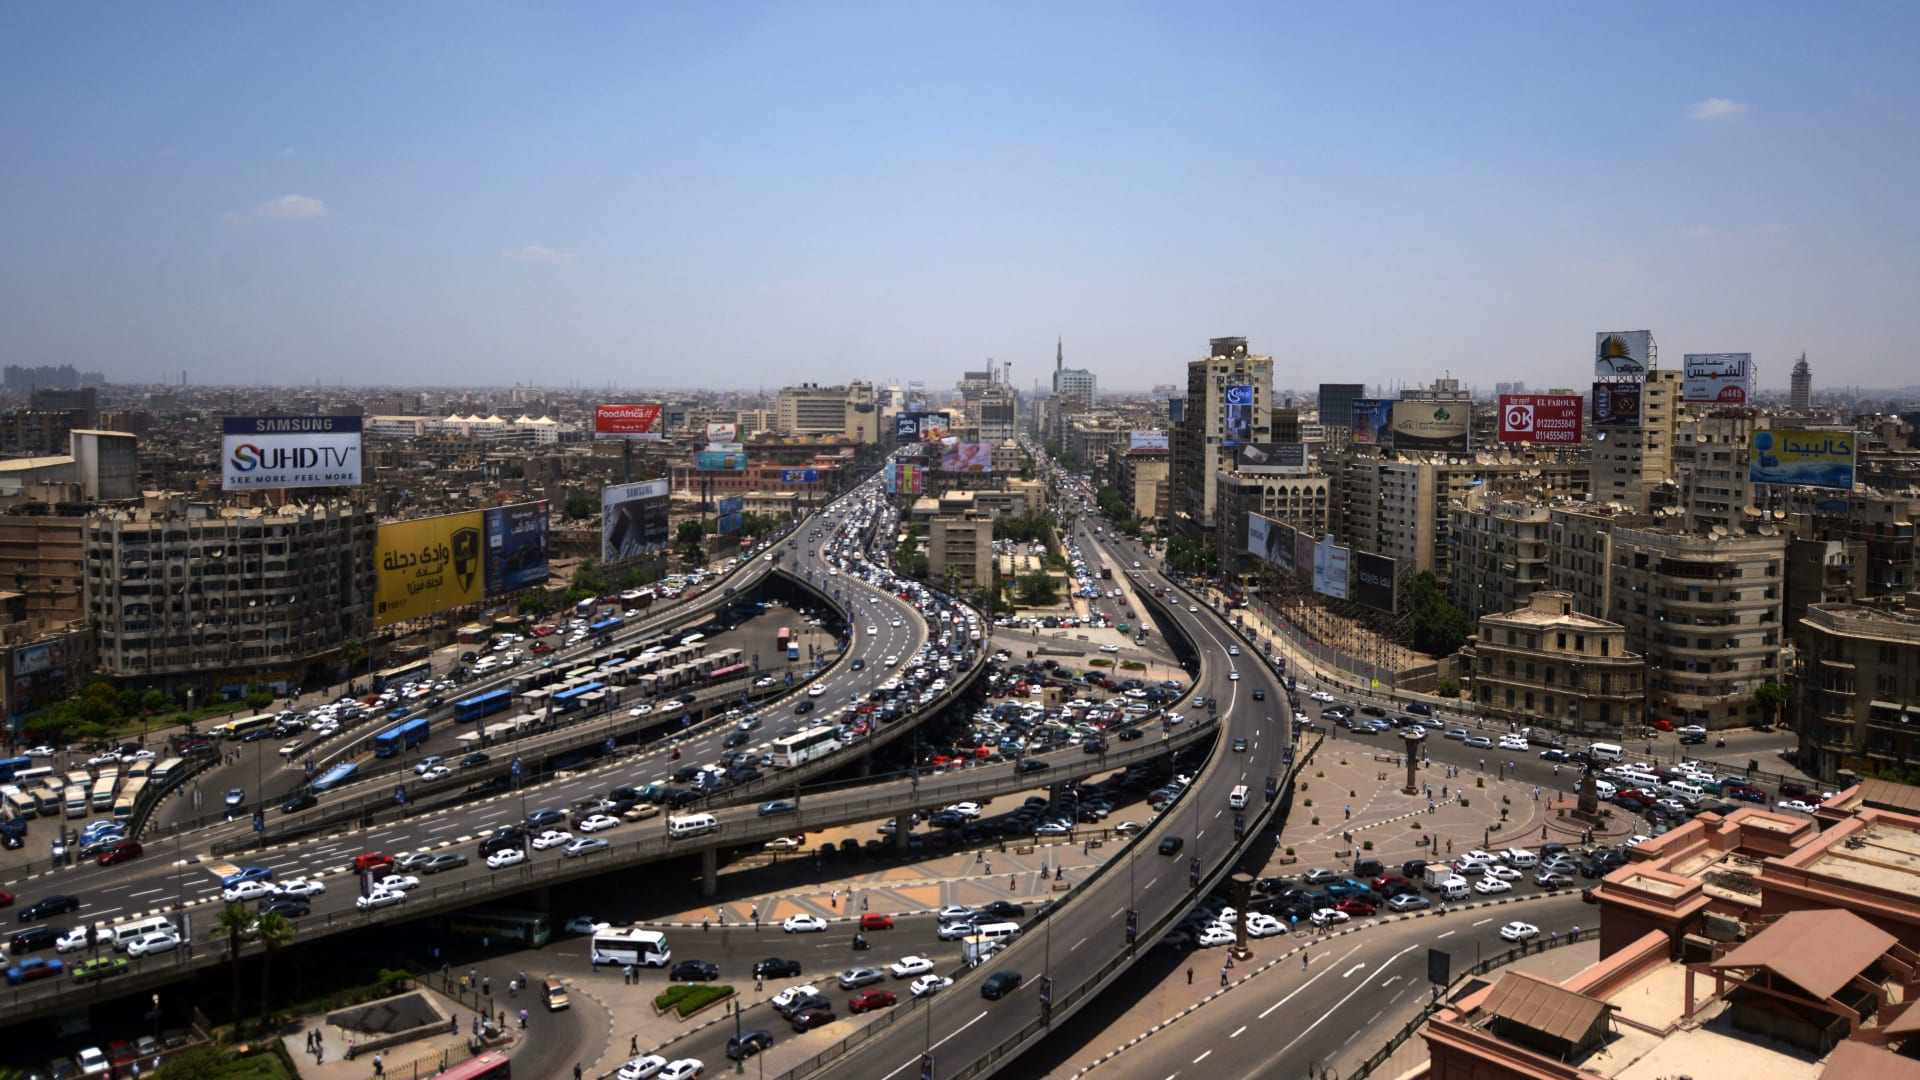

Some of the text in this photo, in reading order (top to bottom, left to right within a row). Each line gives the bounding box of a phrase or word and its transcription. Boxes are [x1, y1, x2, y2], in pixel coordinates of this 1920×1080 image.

[1537, 399, 1576, 407] EL FAROUK
[598, 409, 644, 418] FoodAfrica
[1508, 411, 1532, 425] OK
[256, 418, 333, 432] SAMSUNG
[230, 476, 251, 484] SEE
[256, 475, 291, 483] MORE.
[626, 485, 653, 498] SAMSUNG
[384, 549, 417, 574] دجلة
